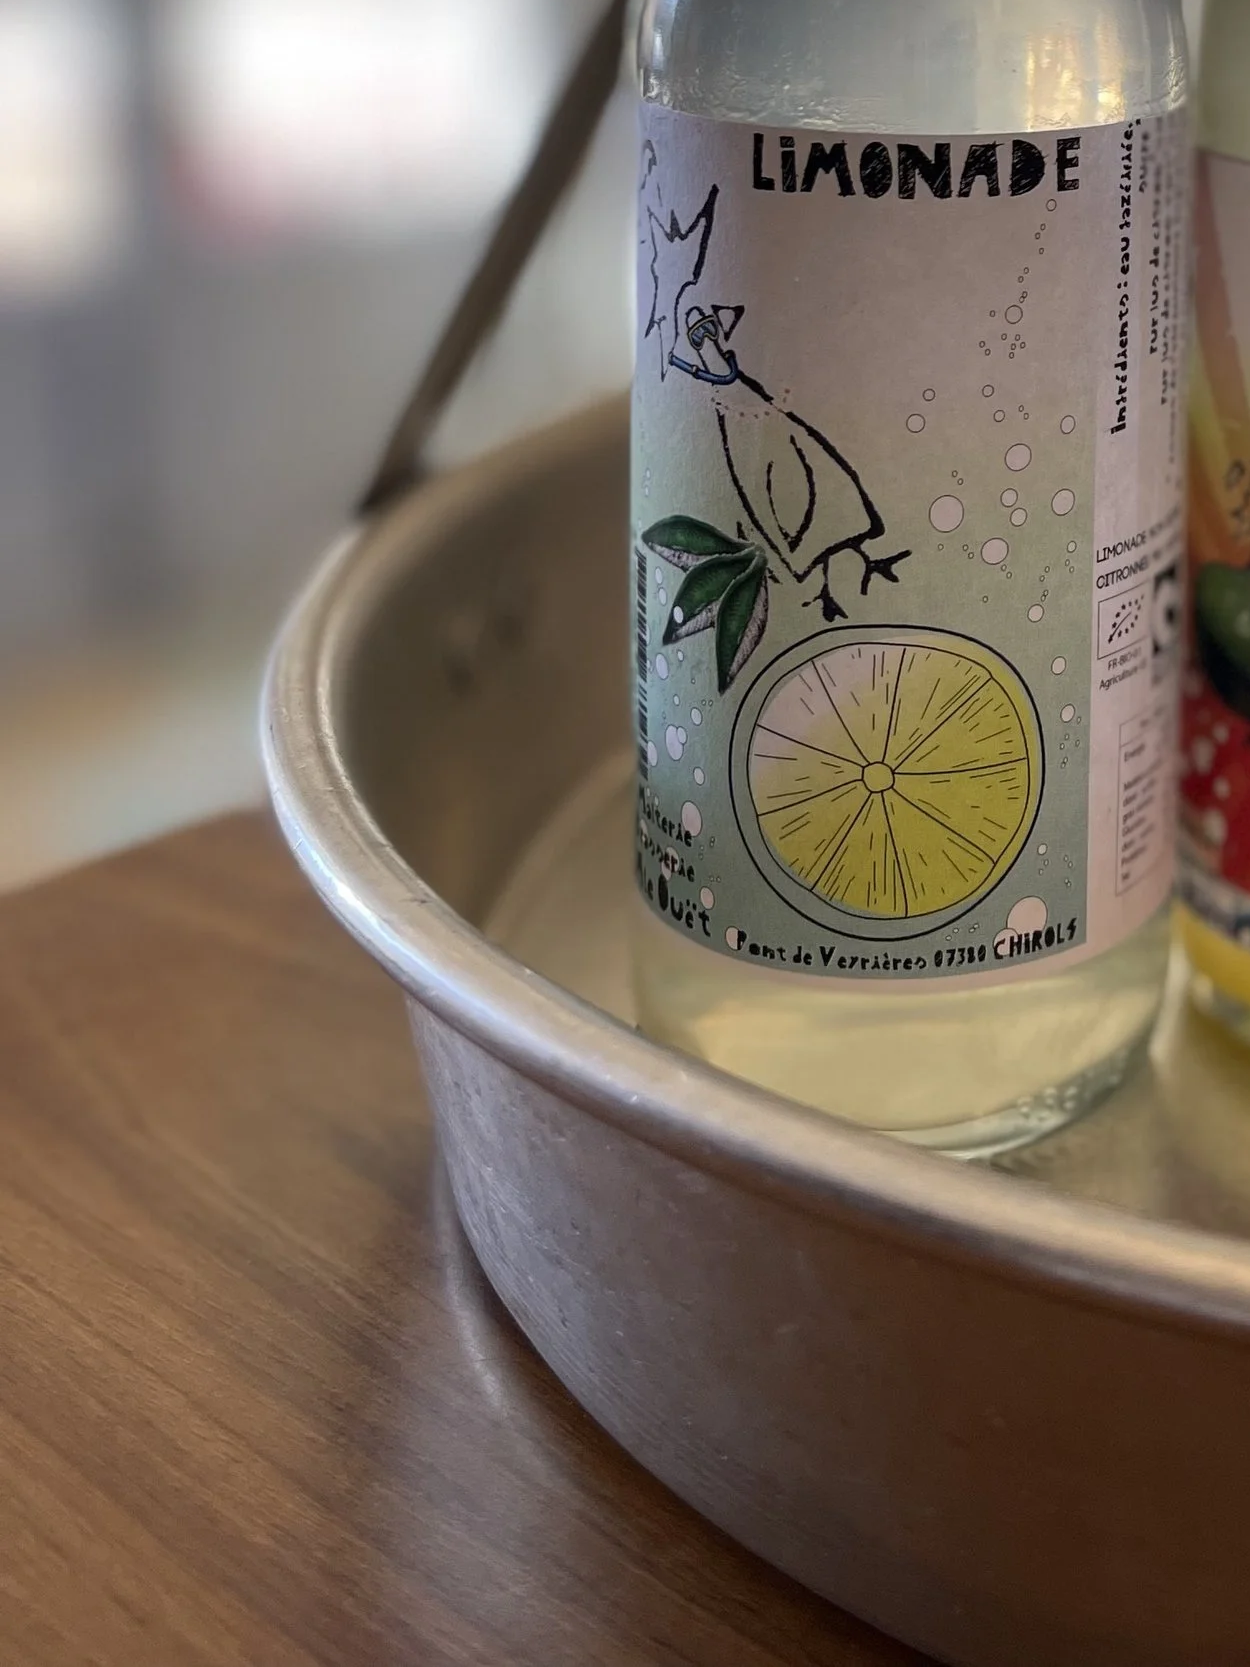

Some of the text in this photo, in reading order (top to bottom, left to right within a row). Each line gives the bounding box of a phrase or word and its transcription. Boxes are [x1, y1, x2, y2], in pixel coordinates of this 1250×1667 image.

[1119, 236, 1130, 276] eau
[793, 946, 813, 966] de
[820, 946, 927, 971] Verrières
[934, 945, 986, 968] 07380
